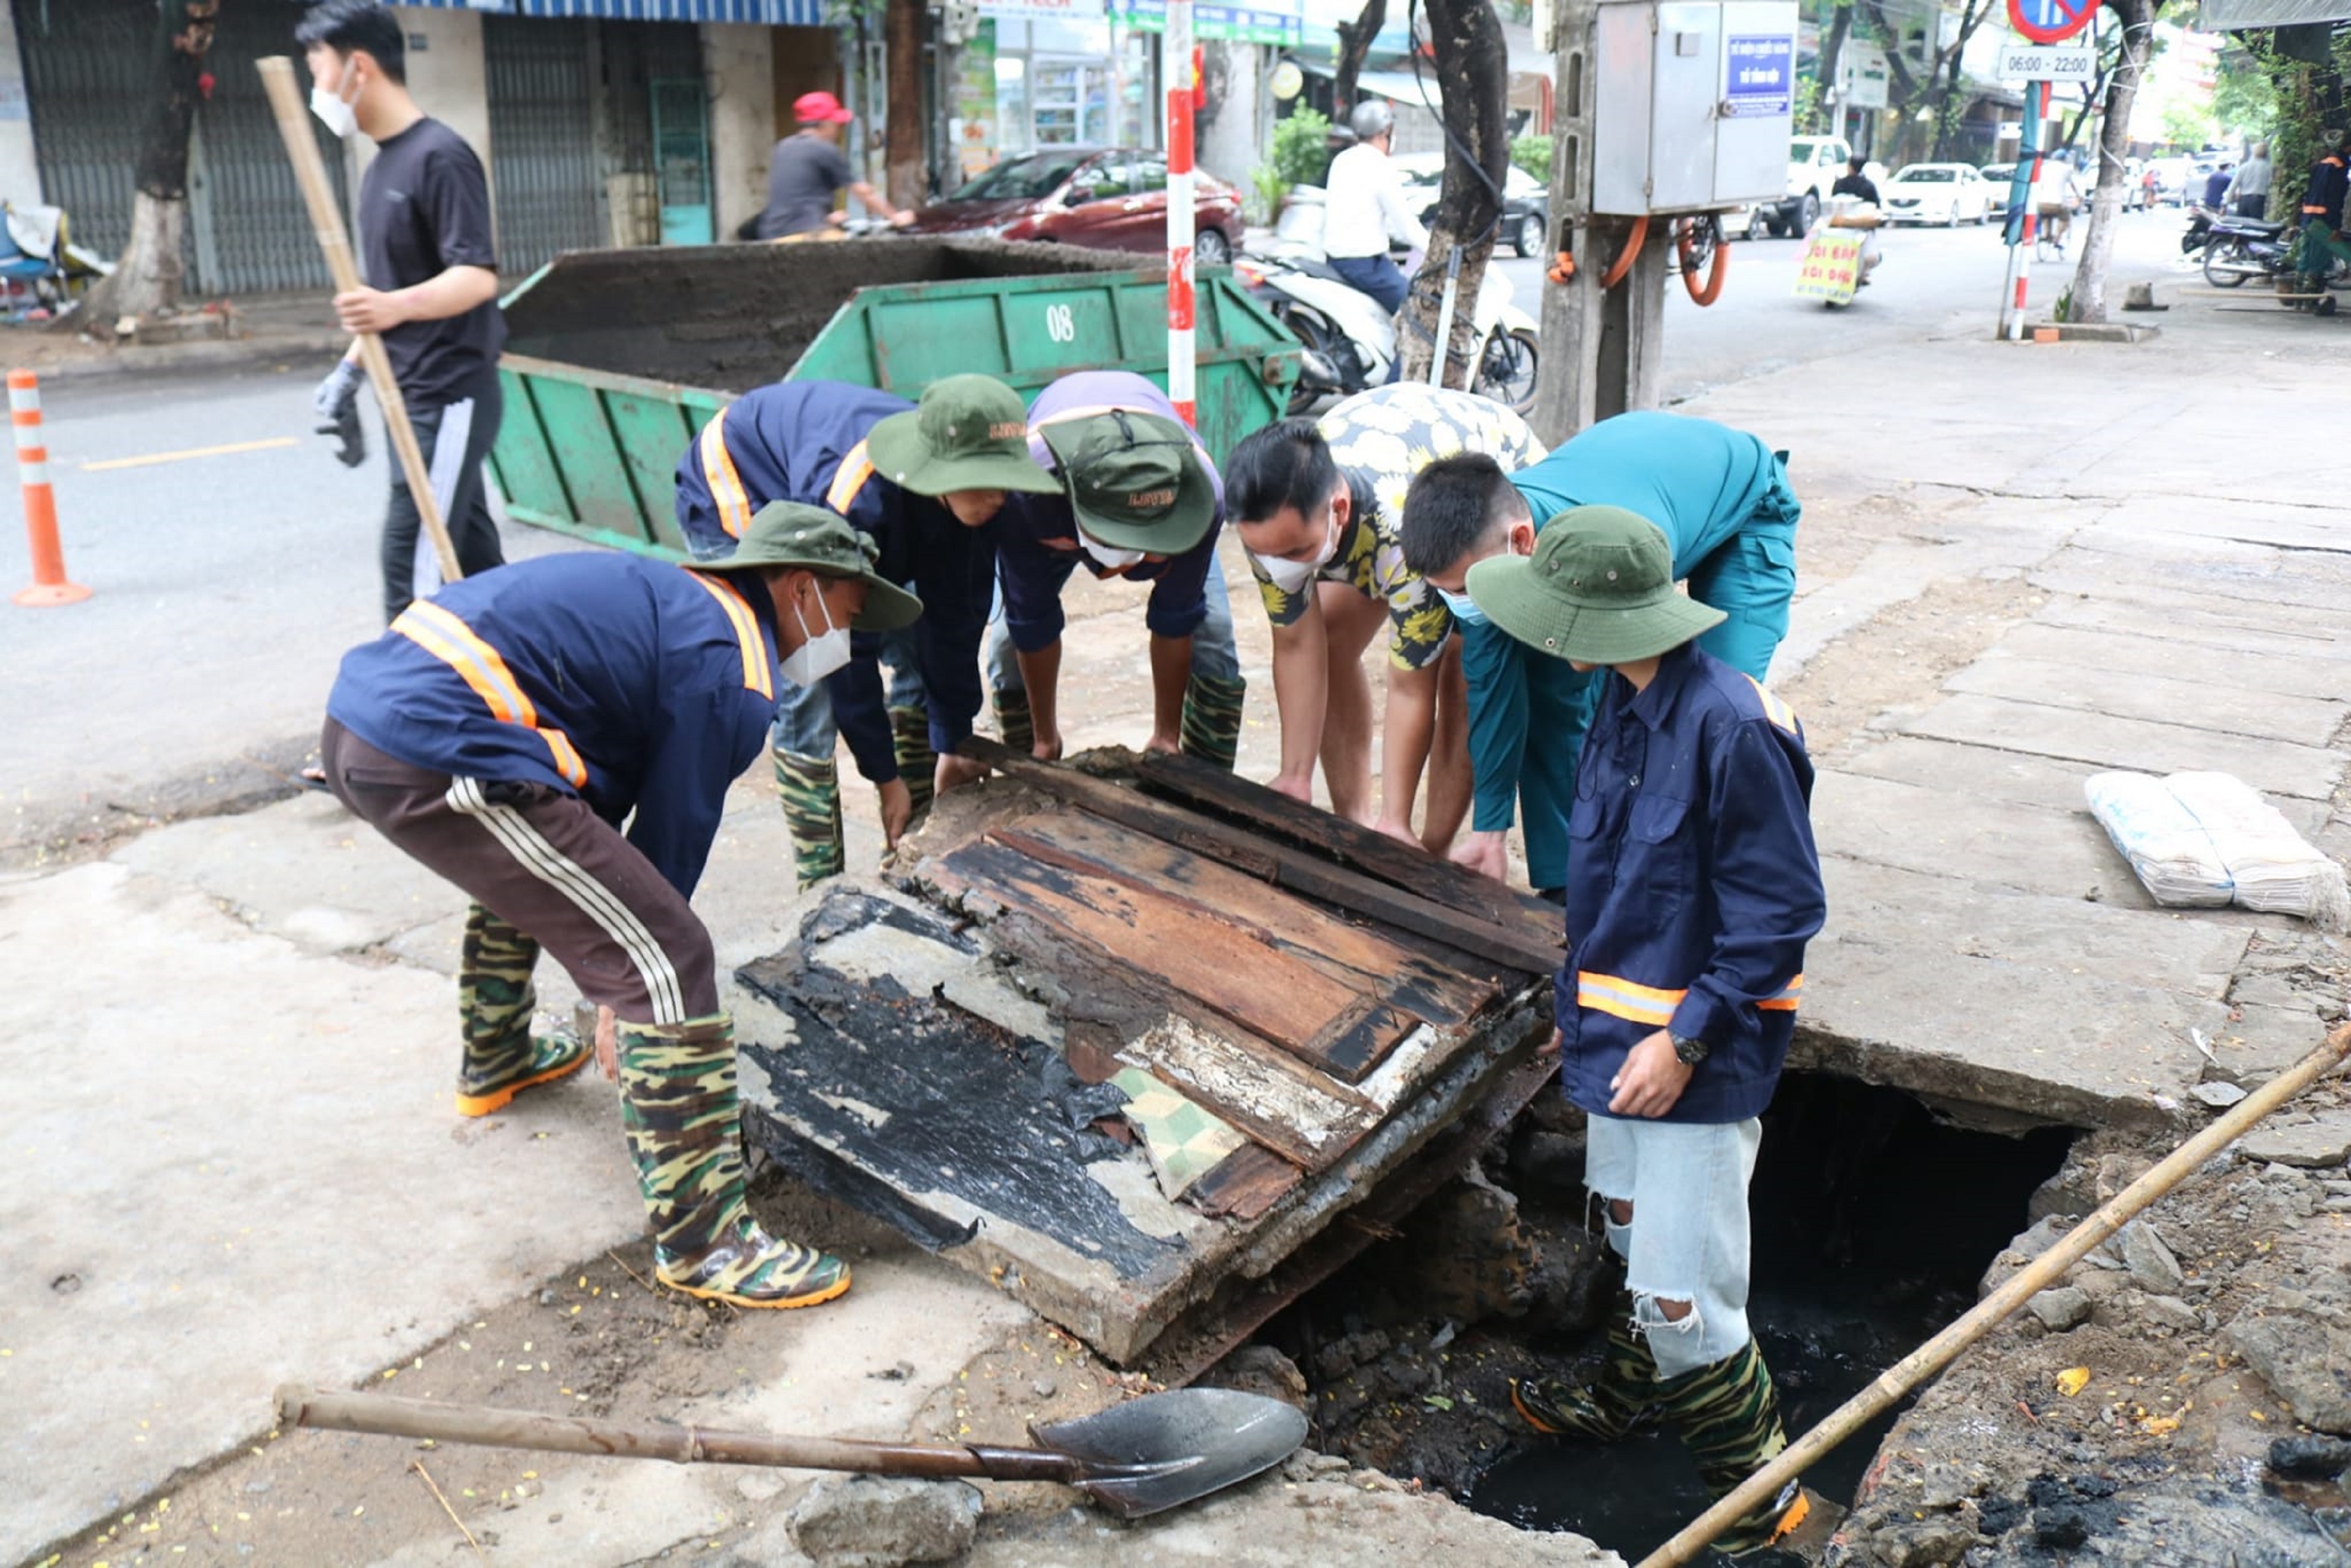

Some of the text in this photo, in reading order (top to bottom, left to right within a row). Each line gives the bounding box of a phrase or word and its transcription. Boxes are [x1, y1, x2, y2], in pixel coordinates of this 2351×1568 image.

[2009, 57, 2041, 71] 06:00
[2054, 57, 2087, 72] 22:00
[1046, 303, 1075, 342] 08
